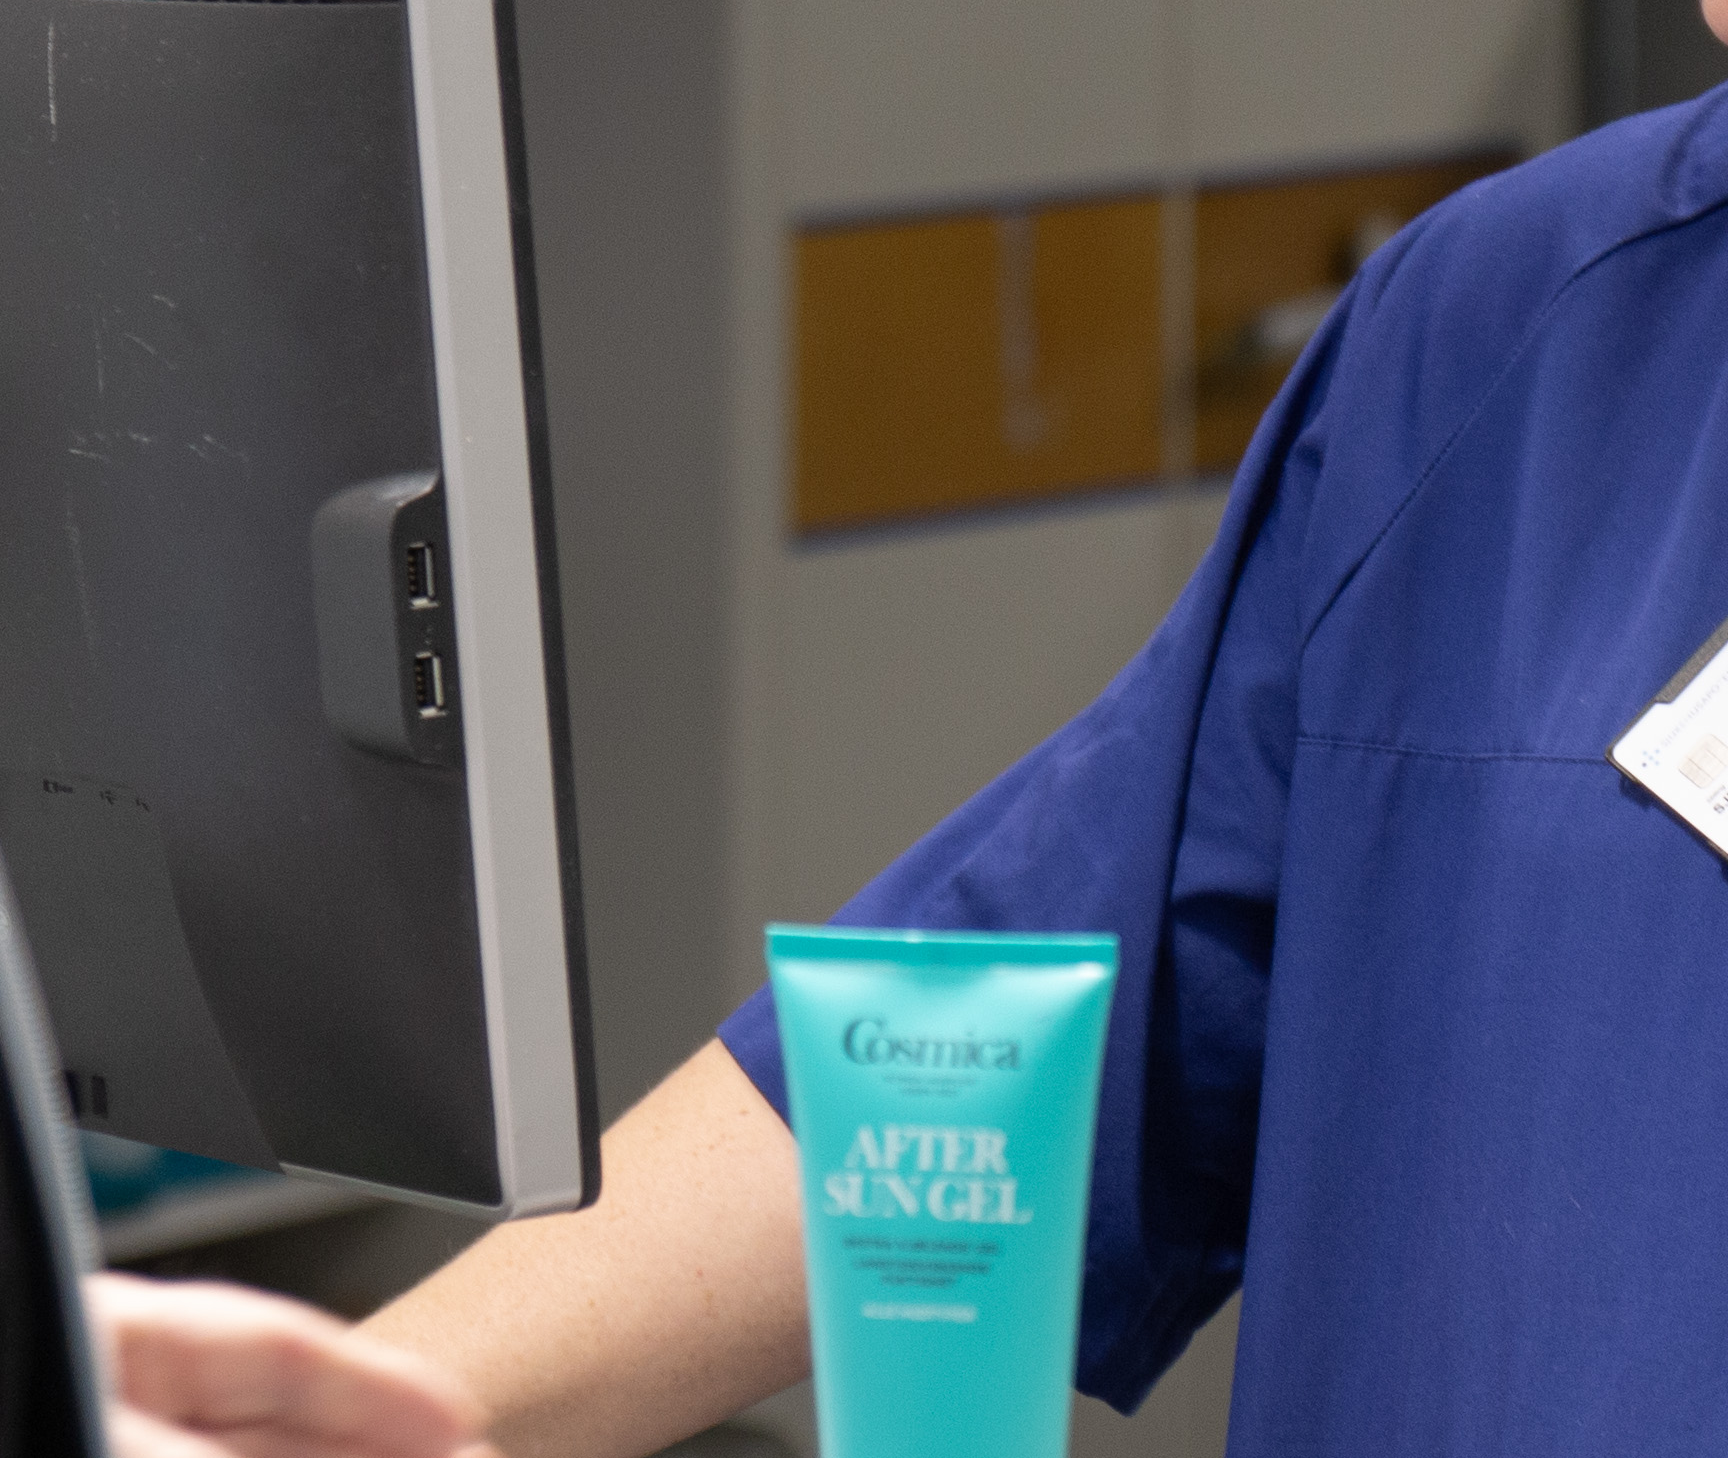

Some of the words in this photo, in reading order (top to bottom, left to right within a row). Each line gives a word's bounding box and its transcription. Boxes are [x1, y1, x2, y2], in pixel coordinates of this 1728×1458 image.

[842, 1018, 1022, 1071] Cosmica
[842, 1123, 1010, 1175] AFTER
[822, 1173, 920, 1219] SUN
[926, 1177, 1035, 1226] GEL
